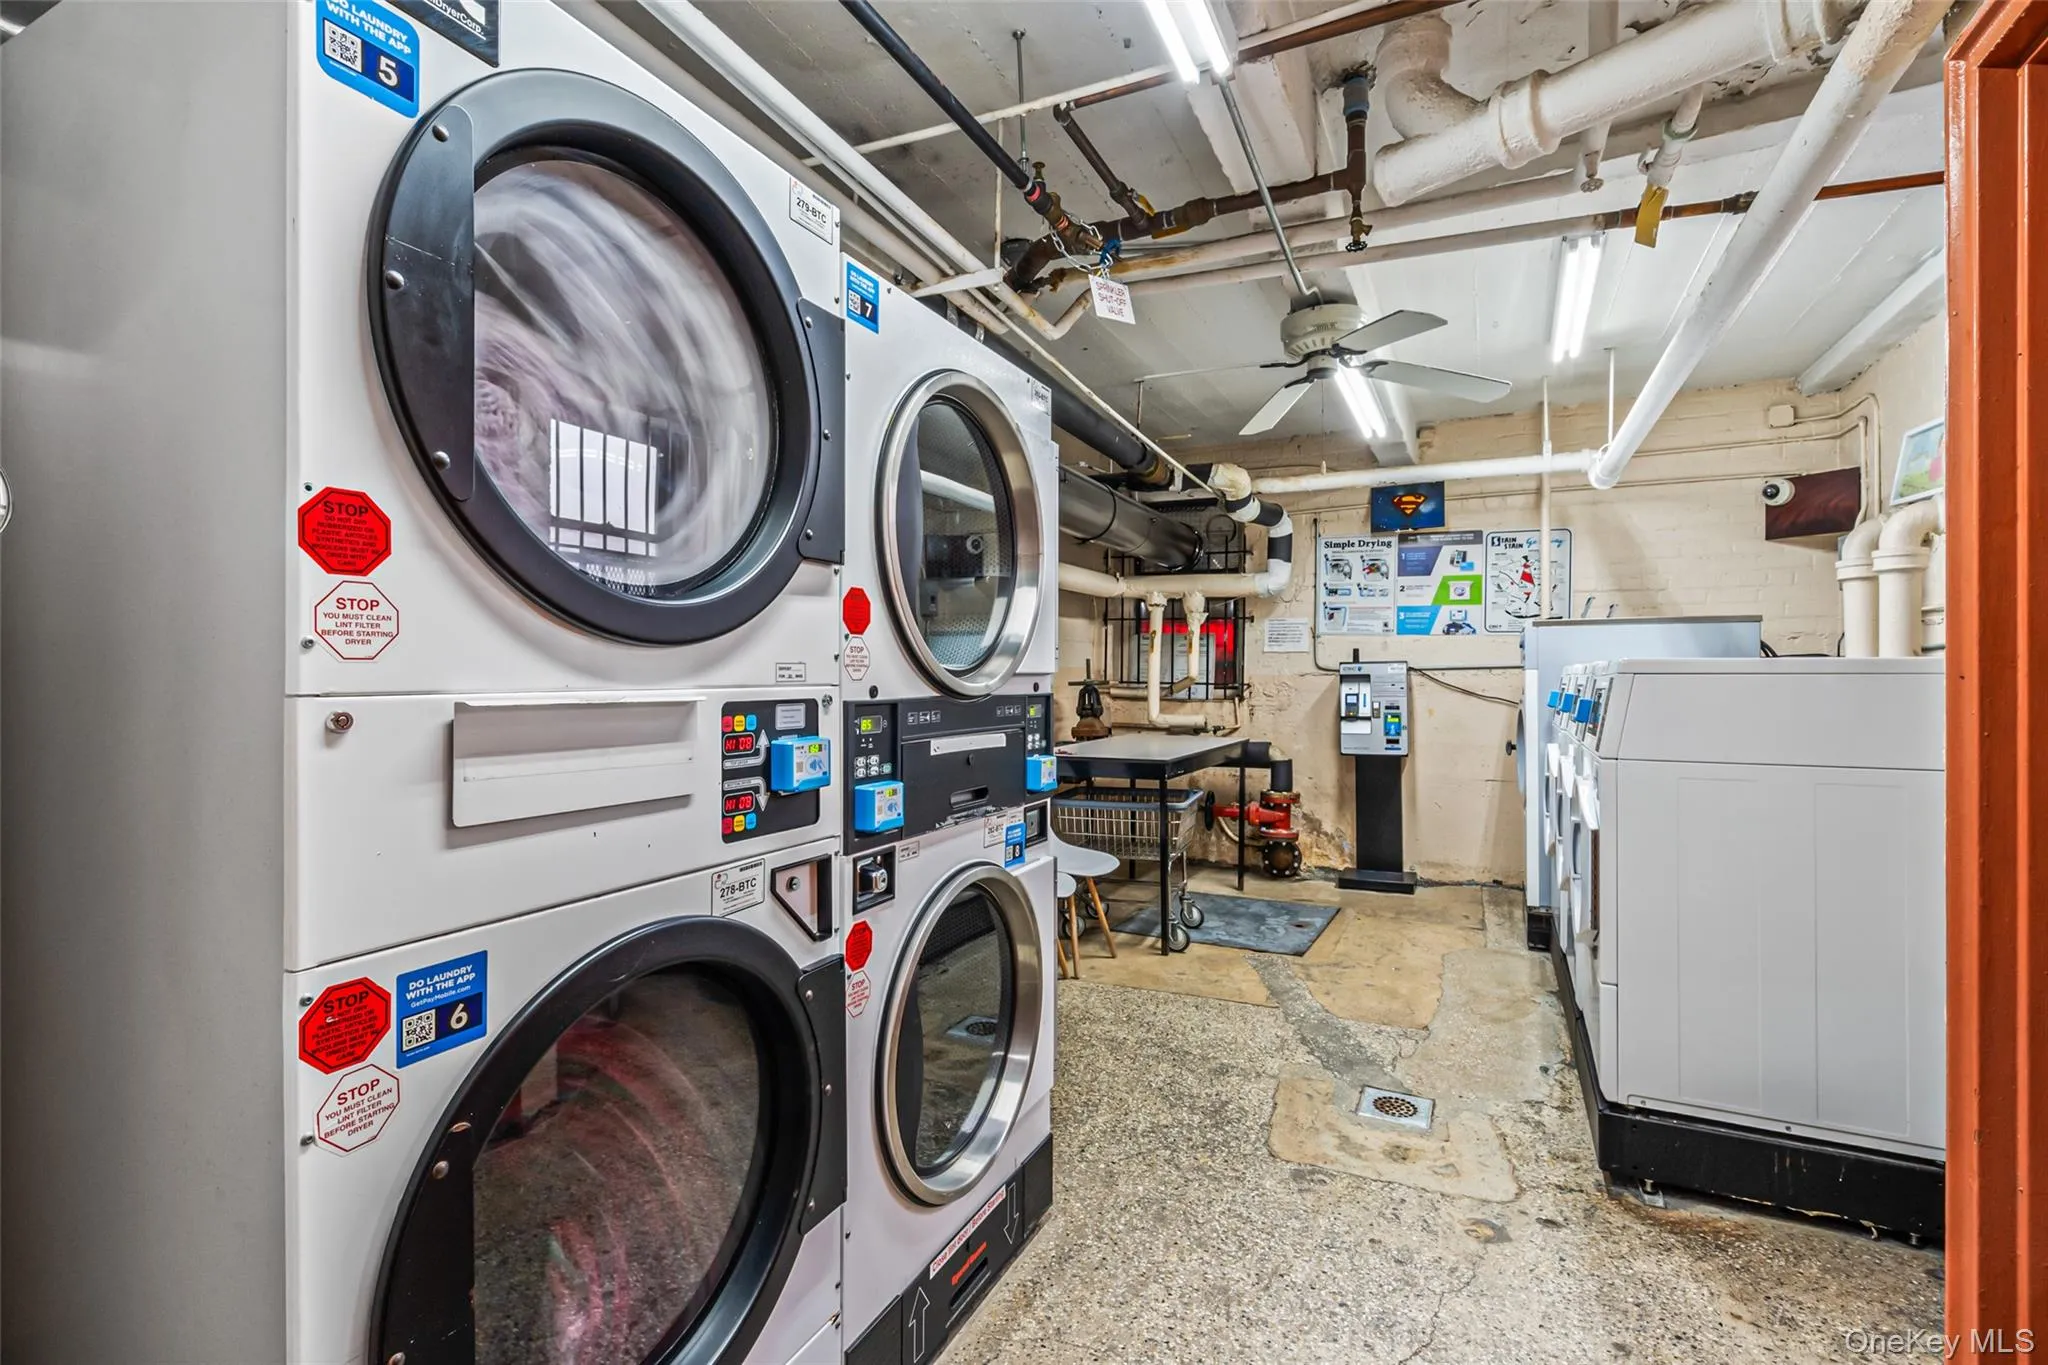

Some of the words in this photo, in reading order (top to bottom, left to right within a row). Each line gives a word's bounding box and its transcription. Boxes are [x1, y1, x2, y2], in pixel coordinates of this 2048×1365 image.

[325, 0, 360, 27] WITH
[362, 20, 387, 41] THE
[389, 37, 412, 54] APP
[351, 4, 409, 41] LAUNDRY
[378, 55, 398, 87] 5
[796, 196, 827, 224] 279-BTC
[1095, 281, 1125, 297] SPRINKLER
[1098, 291, 1126, 306] SHUT-OFF
[864, 301, 873, 318] 7
[1108, 305, 1125, 318] VALVE
[323, 500, 369, 517] STOP
[1324, 540, 1355, 550] Simple
[1357, 539, 1392, 550] Drying
[336, 597, 380, 611] STOP
[1399, 611, 1405, 619] 3
[321, 629, 354, 637] BEFORE
[356, 630, 394, 638] STARTING
[1014, 844, 1020, 857] 8
[720, 877, 757, 899] 278-BTC
[405, 985, 433, 1000] WITH
[435, 979, 455, 991] THE
[457, 972, 476, 985] APP
[408, 979, 424, 991] DO
[427, 964, 473, 985] LAUNDRY
[852, 979, 865, 990] STOP
[323, 990, 369, 1014] STOP
[410, 985, 471, 1008] GetPayMobile.com
[450, 1002, 469, 1030] 6
[337, 1078, 380, 1106] STOP
[325, 1109, 342, 1121] YOU
[344, 1099, 365, 1113] MUST
[367, 1087, 393, 1103] CLEAN
[337, 1114, 355, 1125] LINT
[356, 1100, 382, 1116] FILTER
[323, 1119, 357, 1139] BEFORE
[358, 1102, 395, 1124] STARTING
[347, 1120, 374, 1137] DRYER
